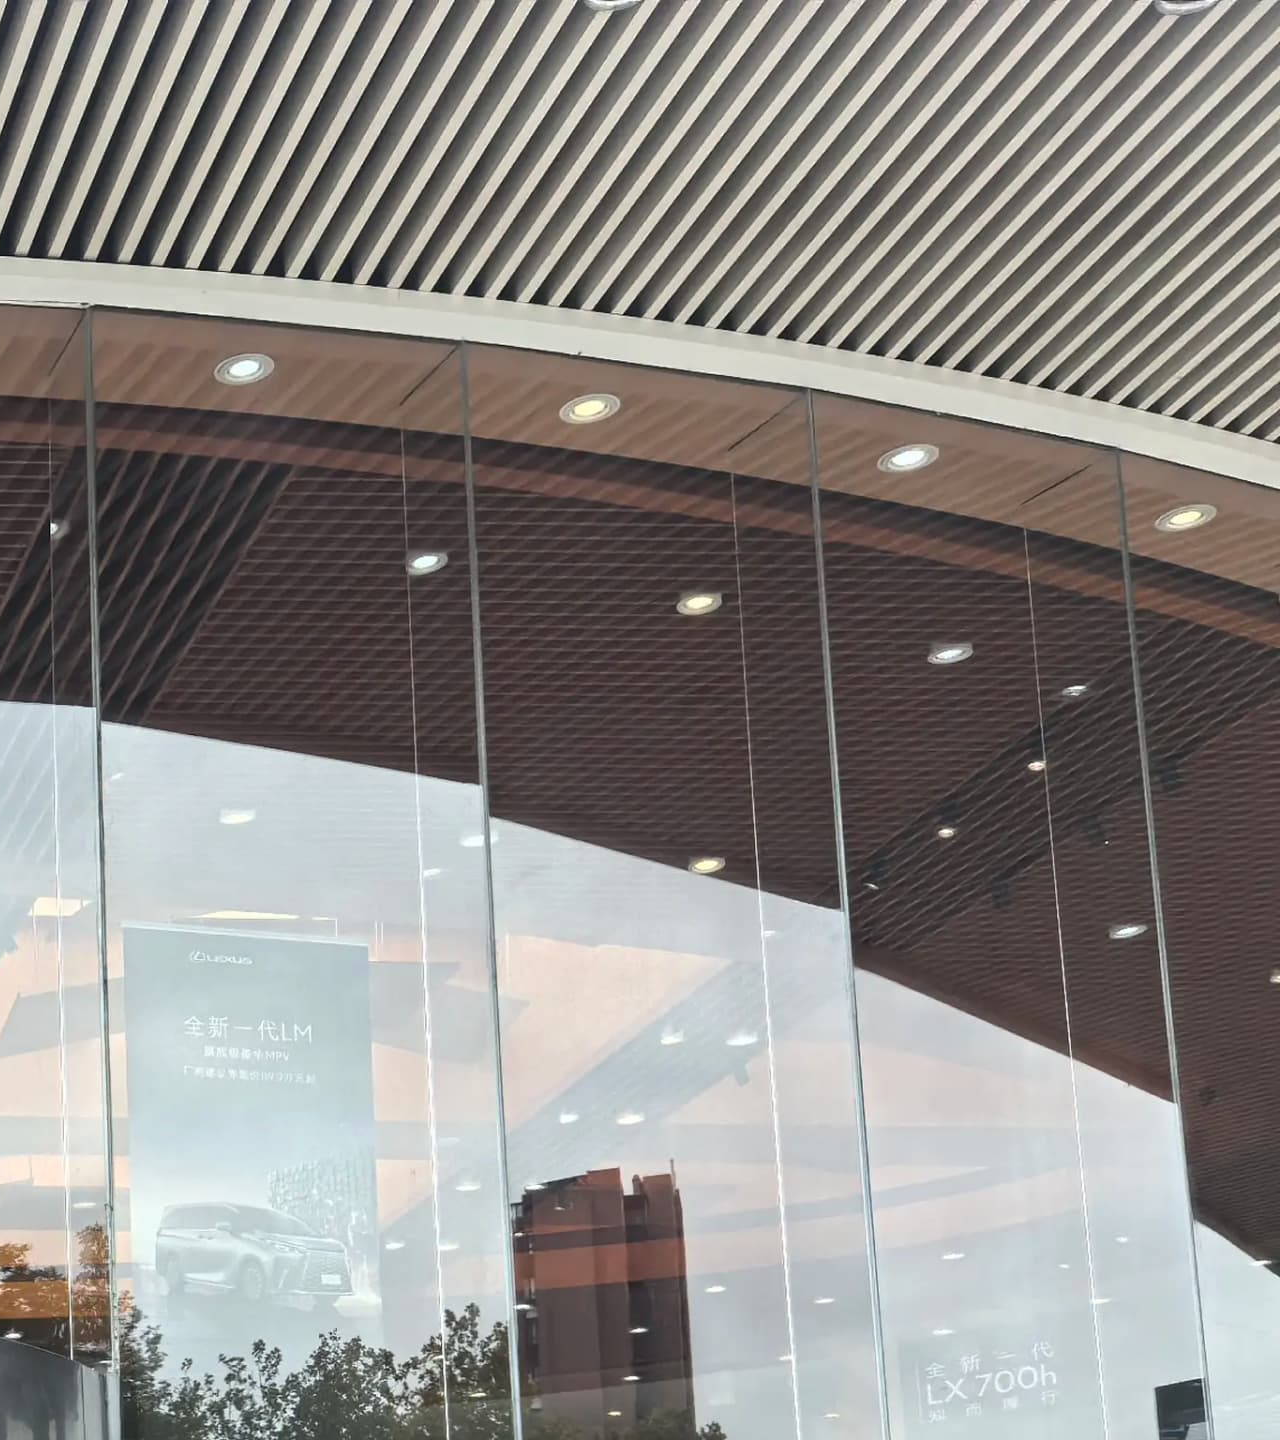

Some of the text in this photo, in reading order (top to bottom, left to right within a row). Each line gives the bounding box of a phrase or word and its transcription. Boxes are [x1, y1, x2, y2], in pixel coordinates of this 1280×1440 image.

[183, 1015, 314, 1044] 全新一代LM
[927, 1364, 1057, 1405] LX 700h
